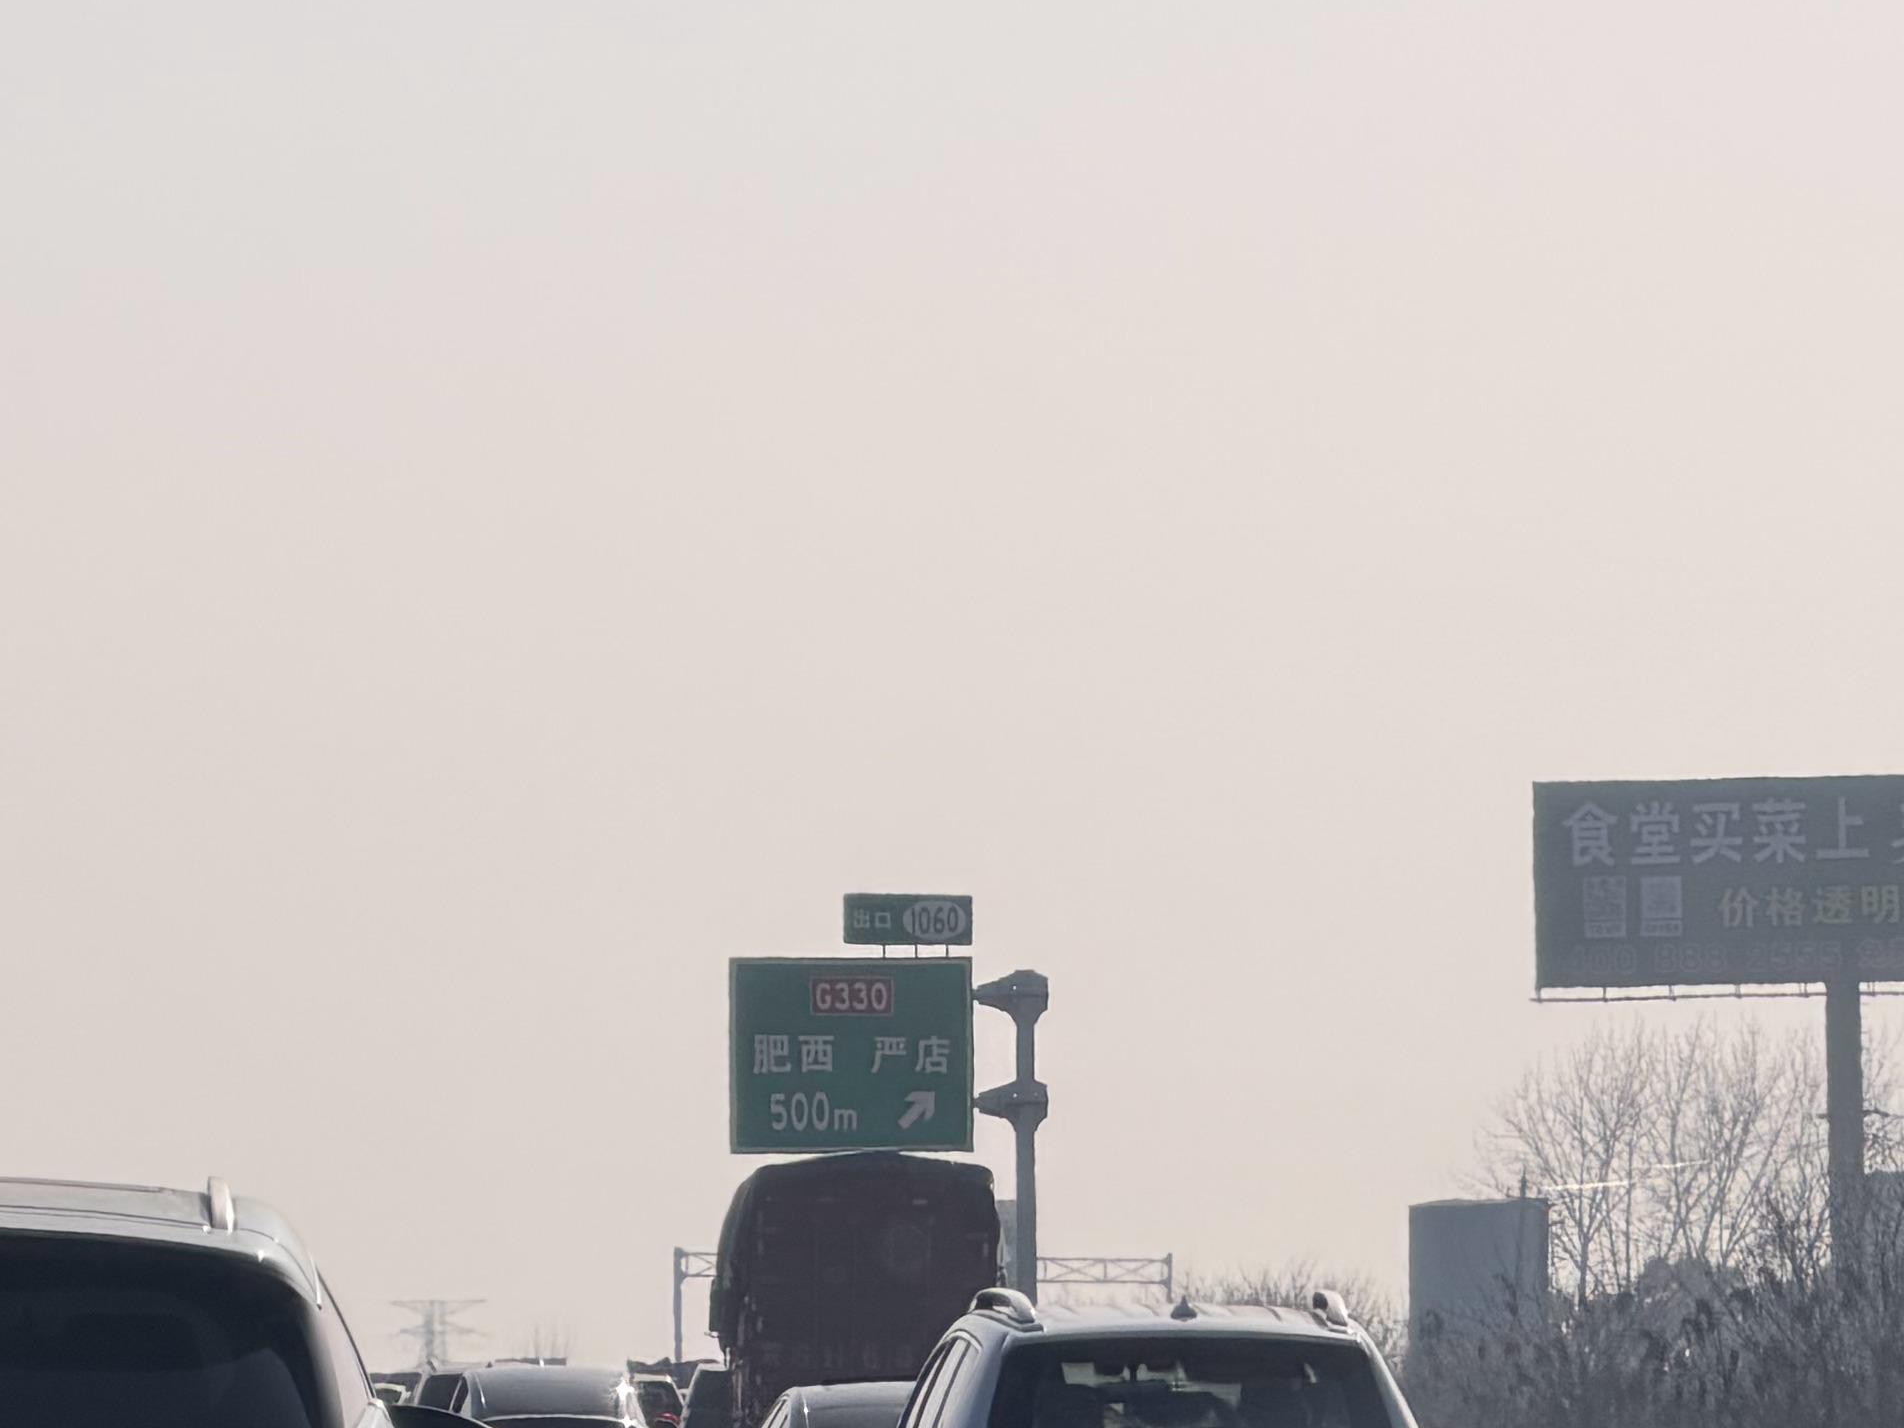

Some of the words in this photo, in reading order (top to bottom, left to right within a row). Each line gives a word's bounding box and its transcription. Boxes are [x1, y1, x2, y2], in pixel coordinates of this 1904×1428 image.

[1562, 797, 1870, 867] 食堂买菜上
[852, 909, 892, 929] 出口
[910, 906, 960, 935] 1060
[1718, 884, 1901, 930] 价格透明
[815, 981, 888, 1011] G330
[752, 1033, 835, 1074] 肥西
[870, 1035, 951, 1074] 严店
[769, 1091, 858, 1132] 500m
